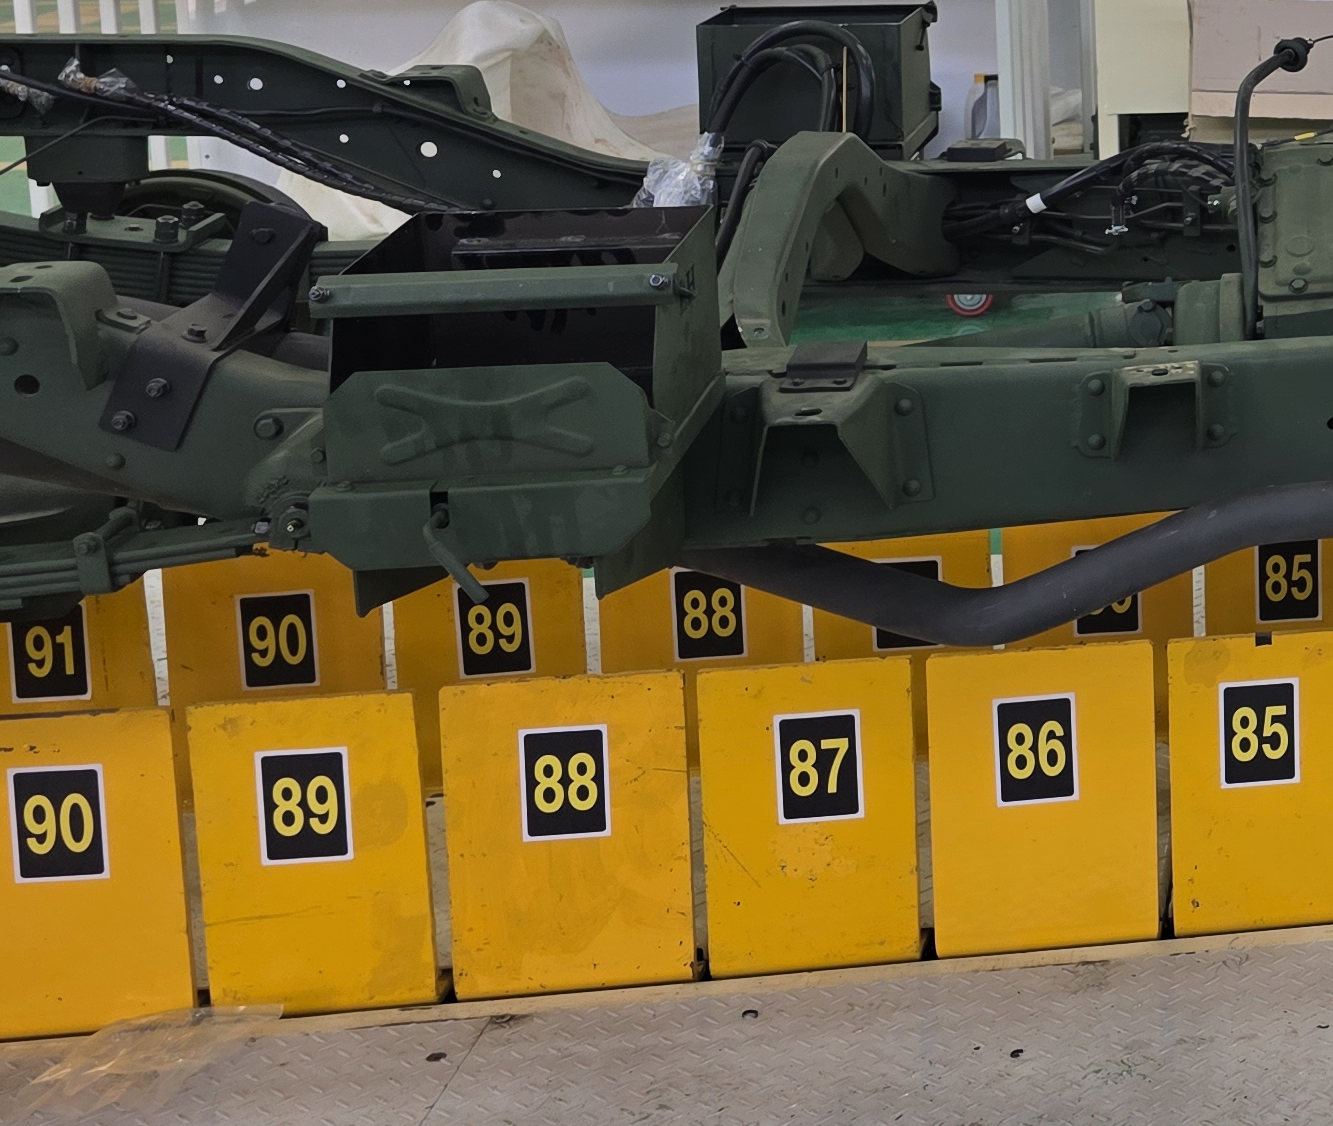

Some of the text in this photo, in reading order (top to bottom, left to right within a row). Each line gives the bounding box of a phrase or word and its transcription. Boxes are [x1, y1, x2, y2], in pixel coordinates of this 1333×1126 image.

[1265, 553, 1313, 602] 85
[248, 613, 307, 667] 90
[467, 602, 523, 655] 89
[683, 587, 737, 639] 88
[24, 624, 76, 679] 91
[1006, 720, 1066, 780] 86
[1231, 704, 1289, 762] 85
[534, 752, 598, 814] 88
[789, 737, 849, 797] 87
[23, 792, 94, 855] 90
[272, 775, 339, 837] 89
